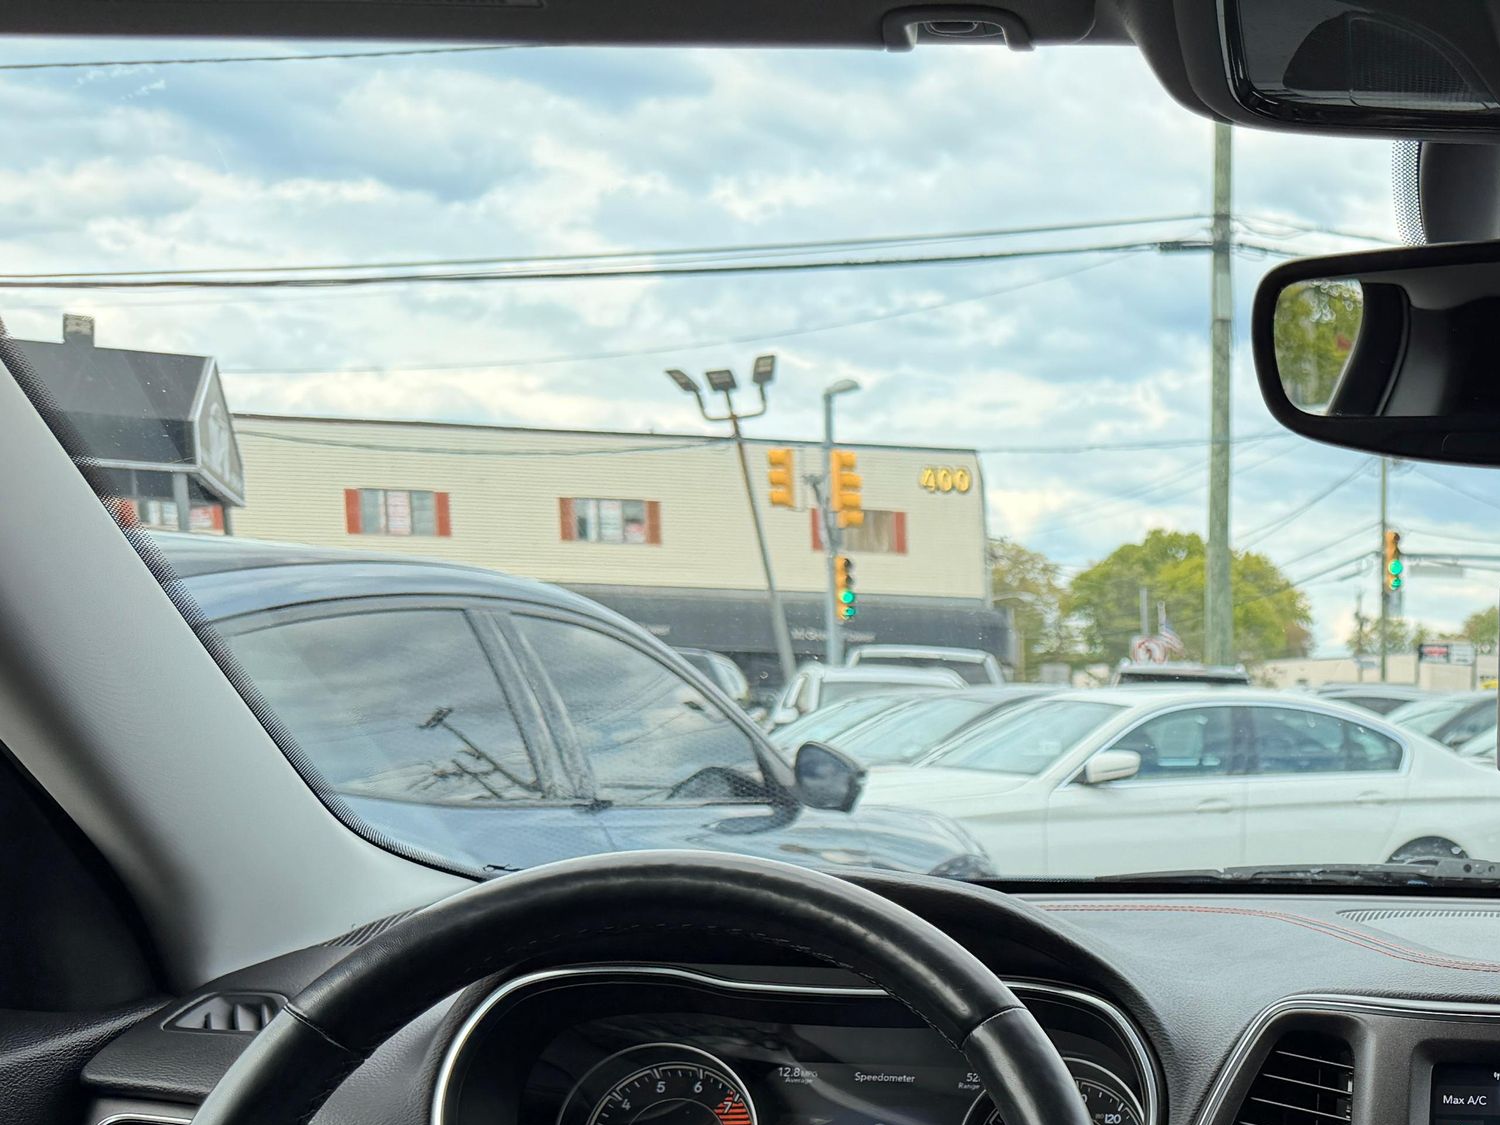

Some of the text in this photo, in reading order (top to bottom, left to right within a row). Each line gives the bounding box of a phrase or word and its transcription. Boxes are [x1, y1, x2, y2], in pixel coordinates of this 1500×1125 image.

[919, 467, 971, 493] 400
[778, 1067, 800, 1077] 12.8
[854, 1072, 916, 1084] Speedometer
[656, 1081, 666, 1093] 5
[693, 1081, 703, 1093] 6
[958, 1082, 981, 1090] Range
[621, 1100, 632, 1110] 4
[1443, 1095, 1487, 1106] Max A/C
[723, 1101, 732, 1114] 7
[1104, 1114, 1122, 1124] 120
